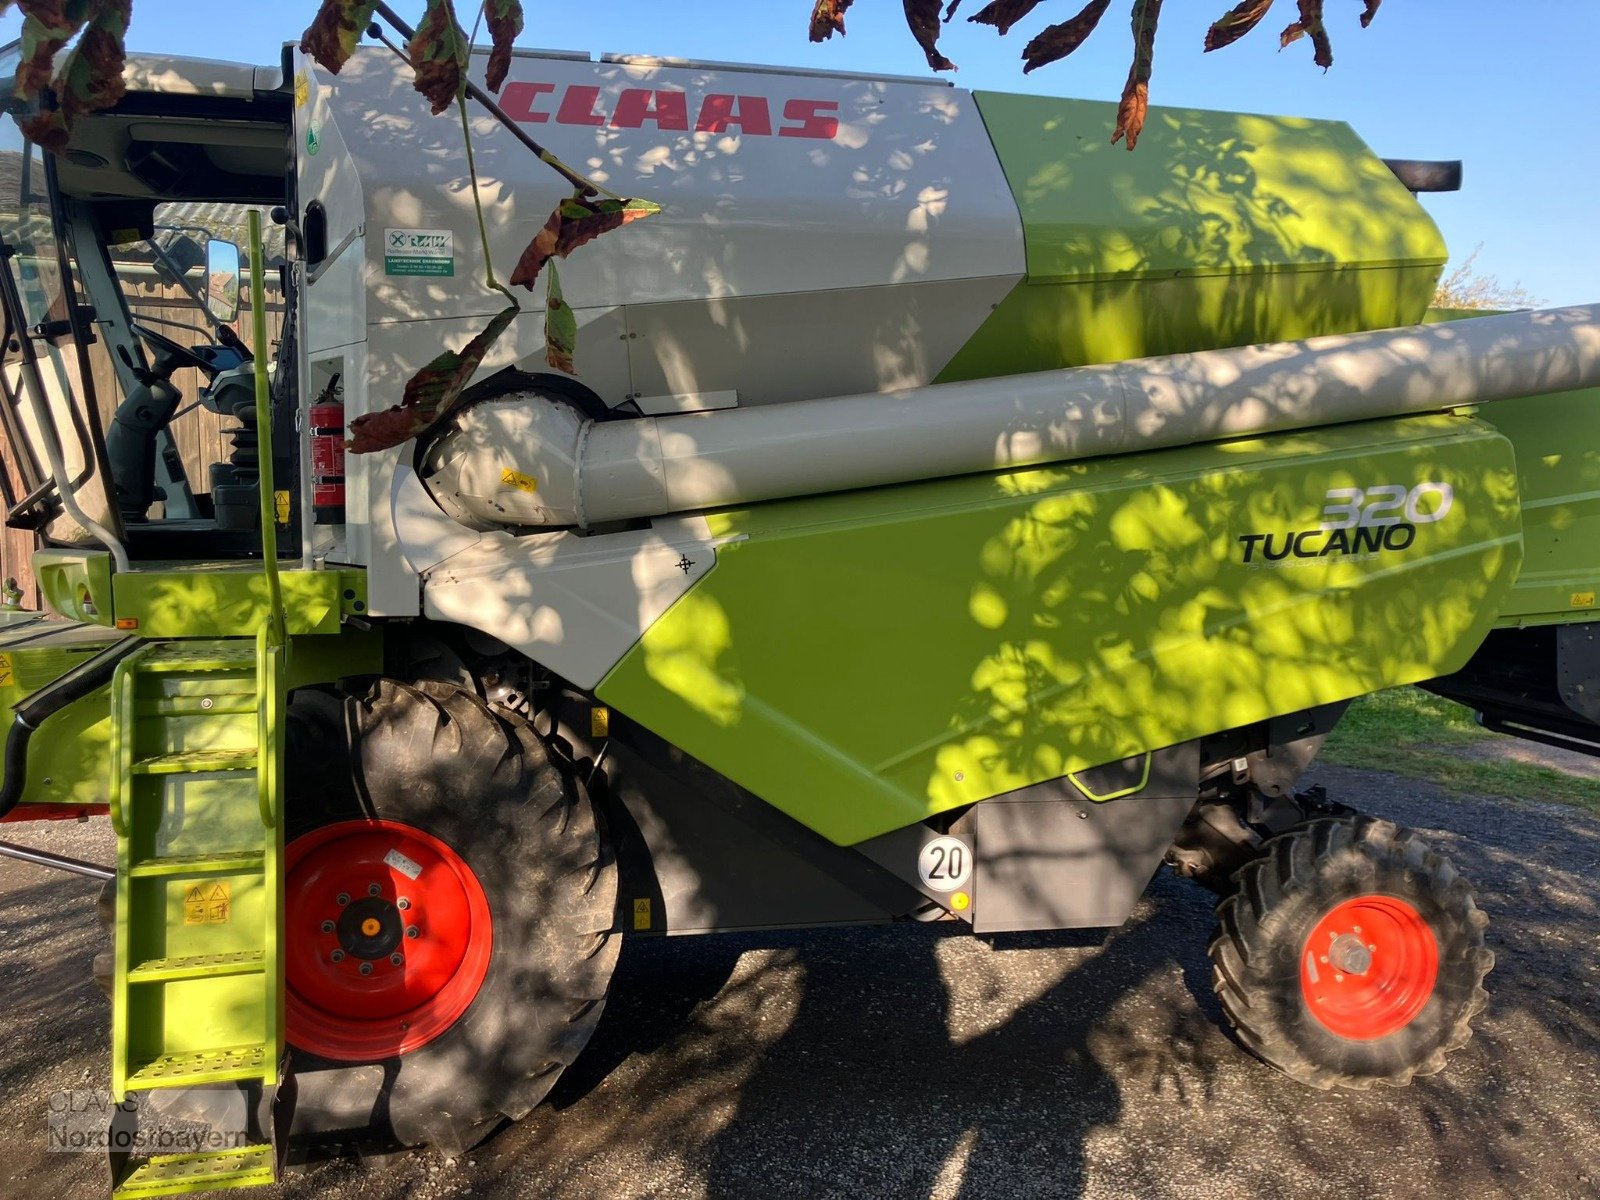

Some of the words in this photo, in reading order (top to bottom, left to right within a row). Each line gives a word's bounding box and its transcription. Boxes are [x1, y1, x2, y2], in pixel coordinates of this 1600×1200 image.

[498, 81, 840, 140] CLAAS
[1319, 482, 1453, 530] 320
[1239, 523, 1416, 563] TUCANO
[928, 846, 963, 880] 20
